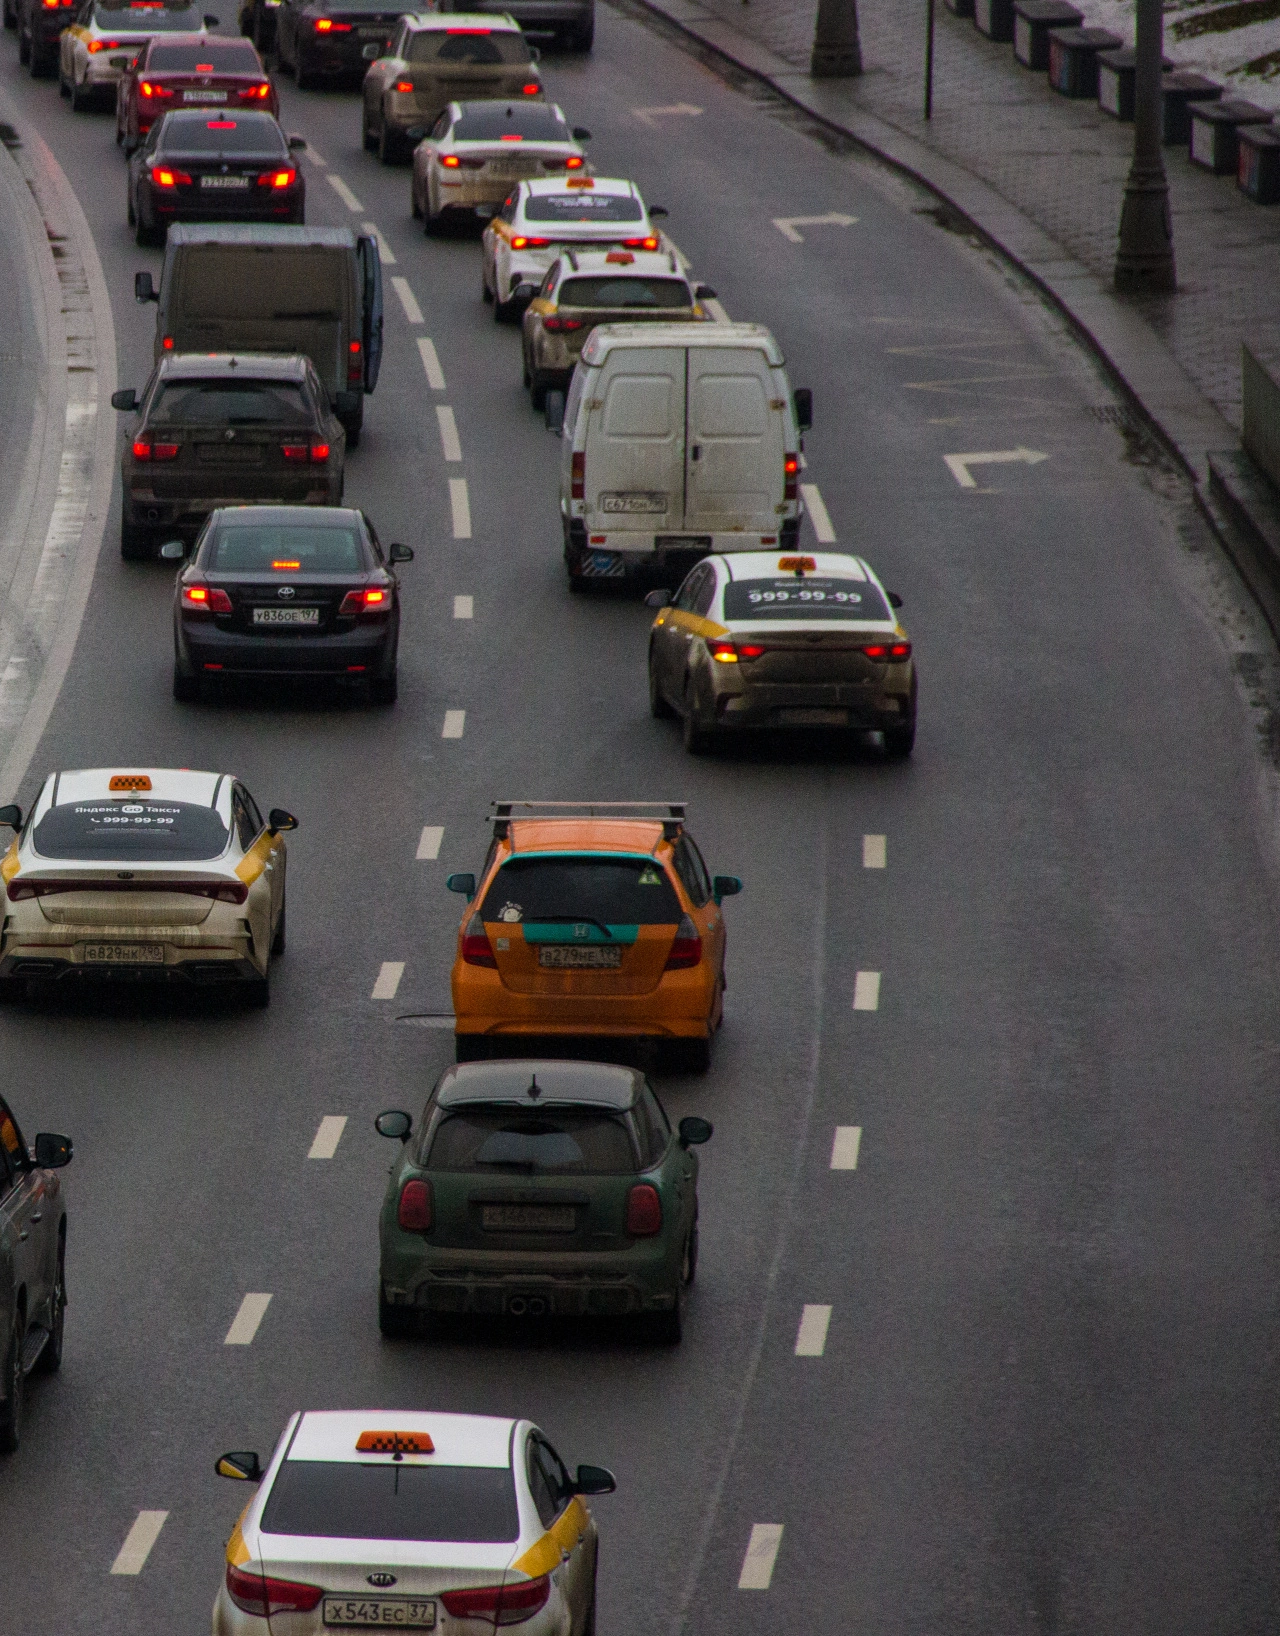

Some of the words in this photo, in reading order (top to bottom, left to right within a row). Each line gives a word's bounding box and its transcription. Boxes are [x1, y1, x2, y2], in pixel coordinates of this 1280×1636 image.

[749, 590, 862, 603] 999-99-99
[146, 806, 180, 814] Такси
[103, 816, 174, 824] 999-99-99
[370, 1574, 394, 1585] KIA
